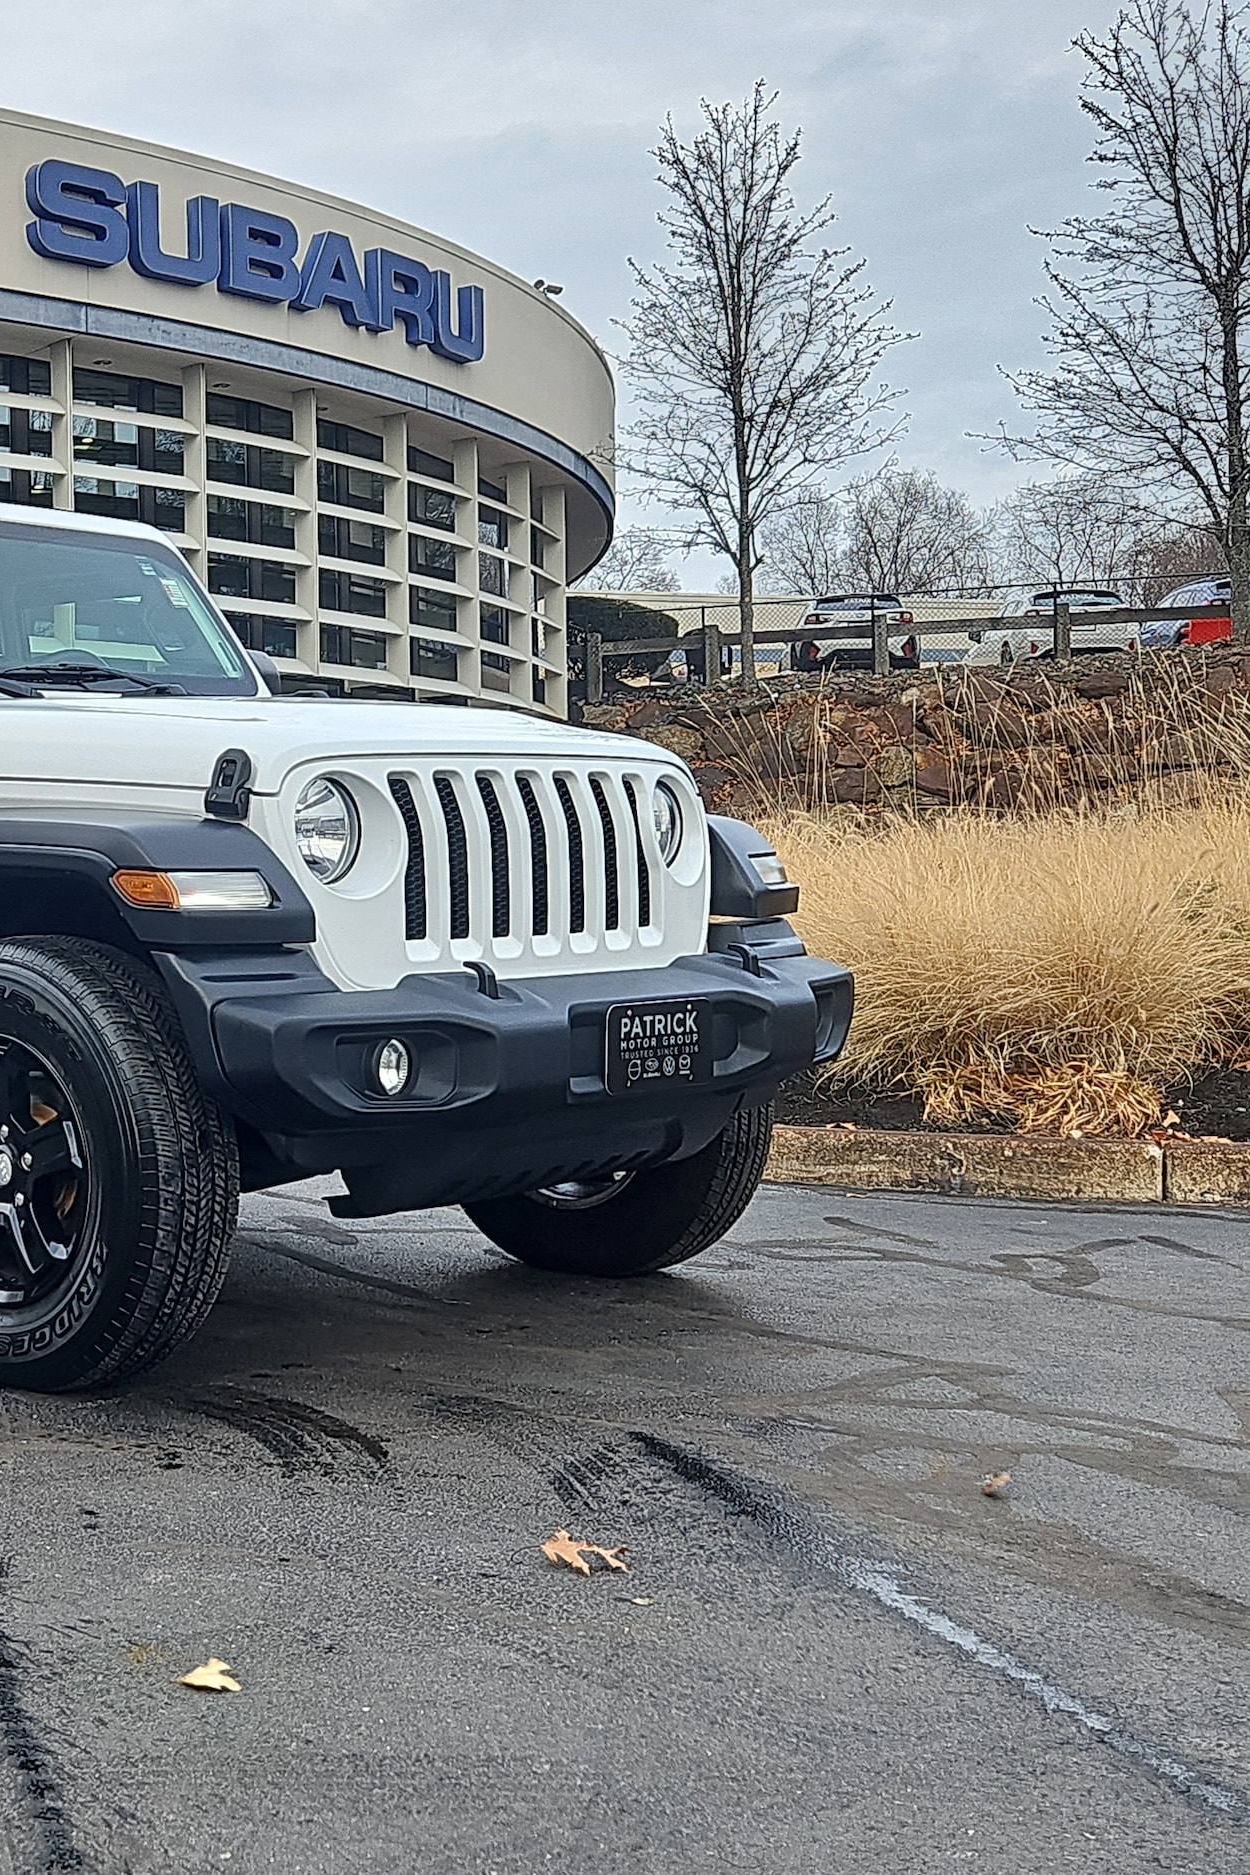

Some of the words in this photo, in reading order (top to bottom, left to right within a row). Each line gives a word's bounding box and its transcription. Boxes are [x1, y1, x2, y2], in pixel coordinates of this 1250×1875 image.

[25, 157, 485, 364] SUBARU
[621, 1011, 698, 1039] PATRICK
[620, 1037, 657, 1050] MOTOR
[662, 1033, 699, 1046] GROUP
[621, 1050, 654, 1060] TRUSTED
[657, 1047, 679, 1056] SINCE
[681, 1045, 699, 1053] 1936
